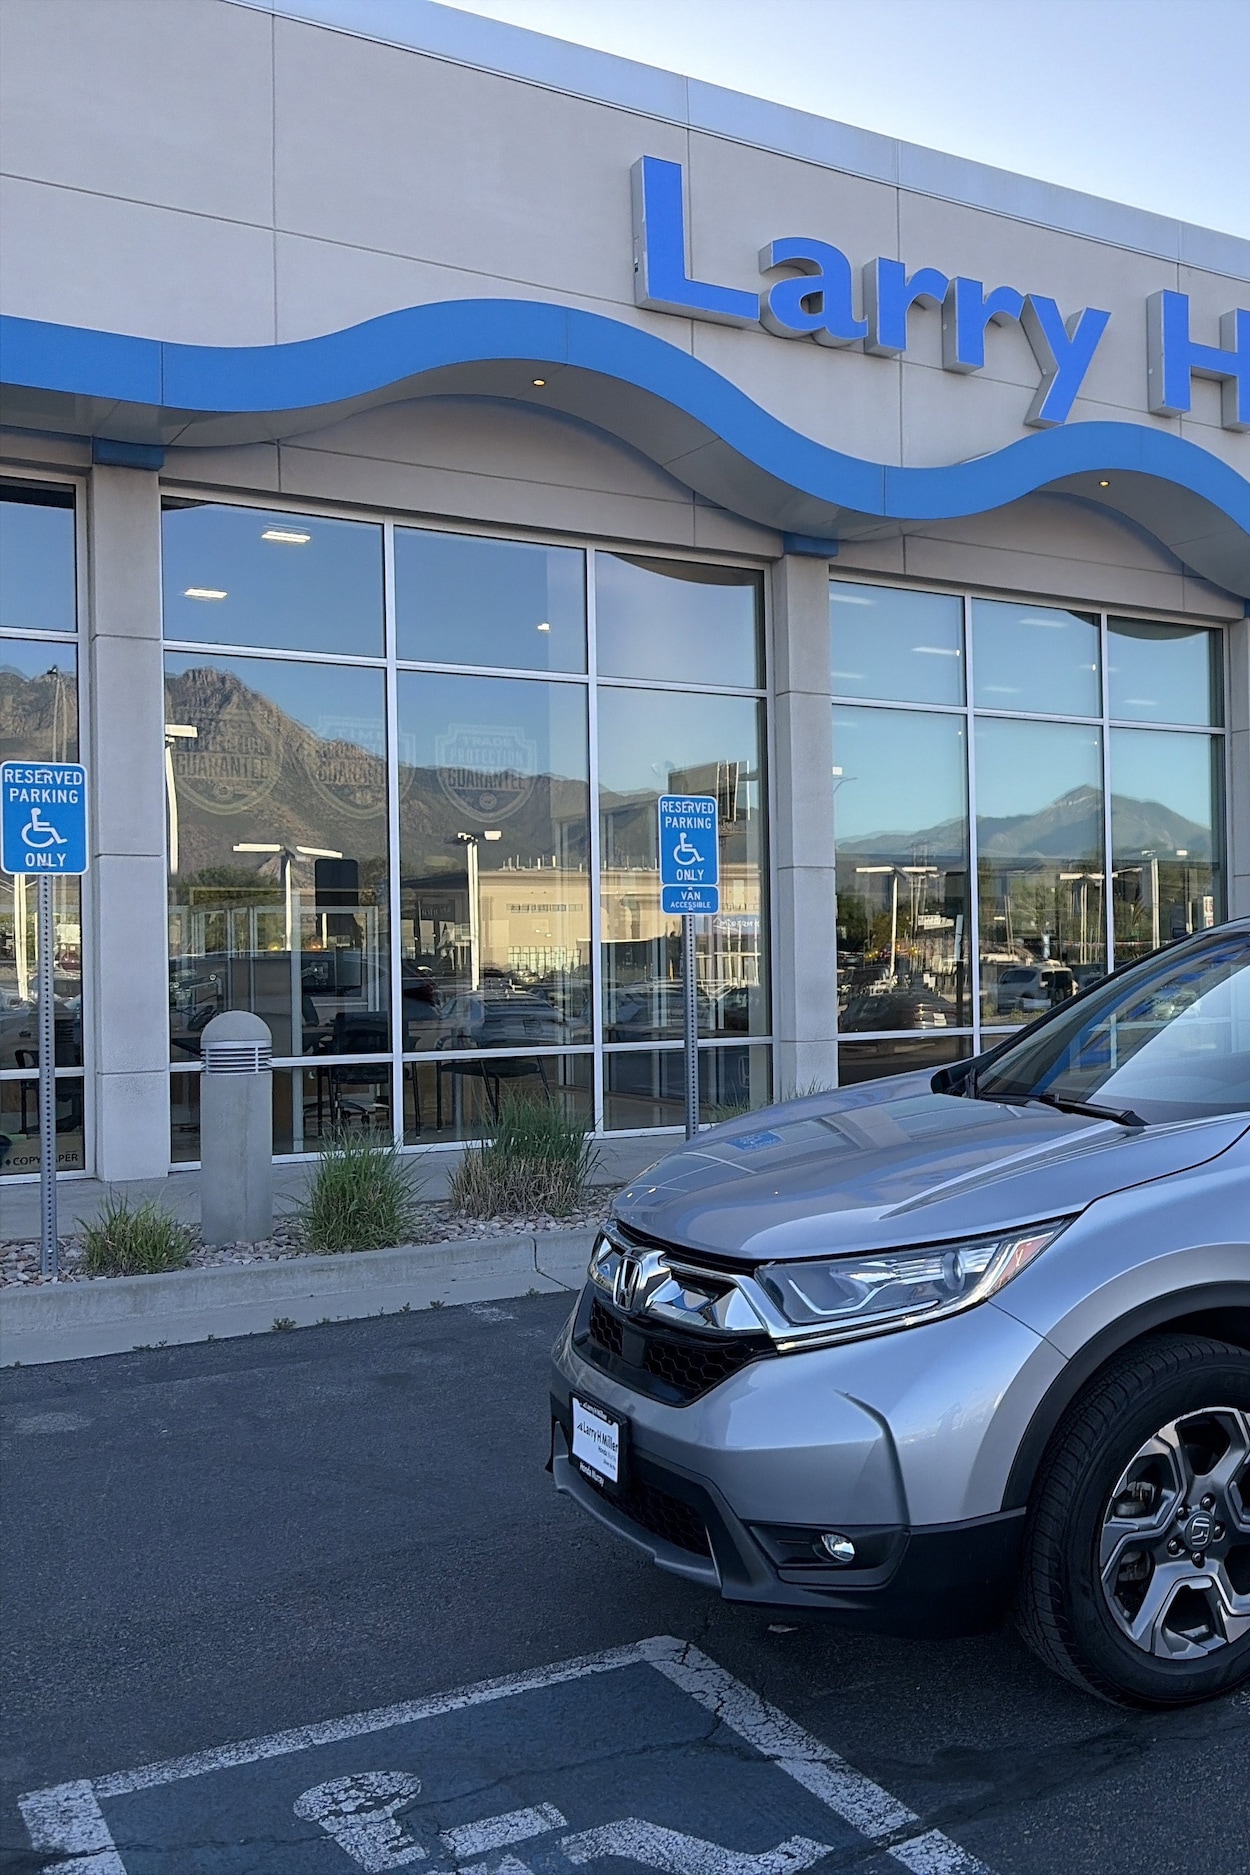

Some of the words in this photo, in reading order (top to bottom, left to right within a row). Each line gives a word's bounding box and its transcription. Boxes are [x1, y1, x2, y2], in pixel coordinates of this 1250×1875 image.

[632, 155, 1111, 428] Larry
[4, 768, 83, 785] RESERVED
[9, 788, 79, 804] PARKING
[661, 801, 714, 814] RESERVED
[665, 816, 712, 829] PARKING
[25, 852, 67, 867] ONLY
[676, 869, 704, 881] ONLY
[681, 891, 701, 900] VAN
[670, 901, 711, 909] ACCESSIBLE
[13, 1156, 40, 1166] COPY
[583, 1421, 597, 1442] Larry
[597, 1430, 602, 1443] H
[602, 1432, 618, 1452] Miller
